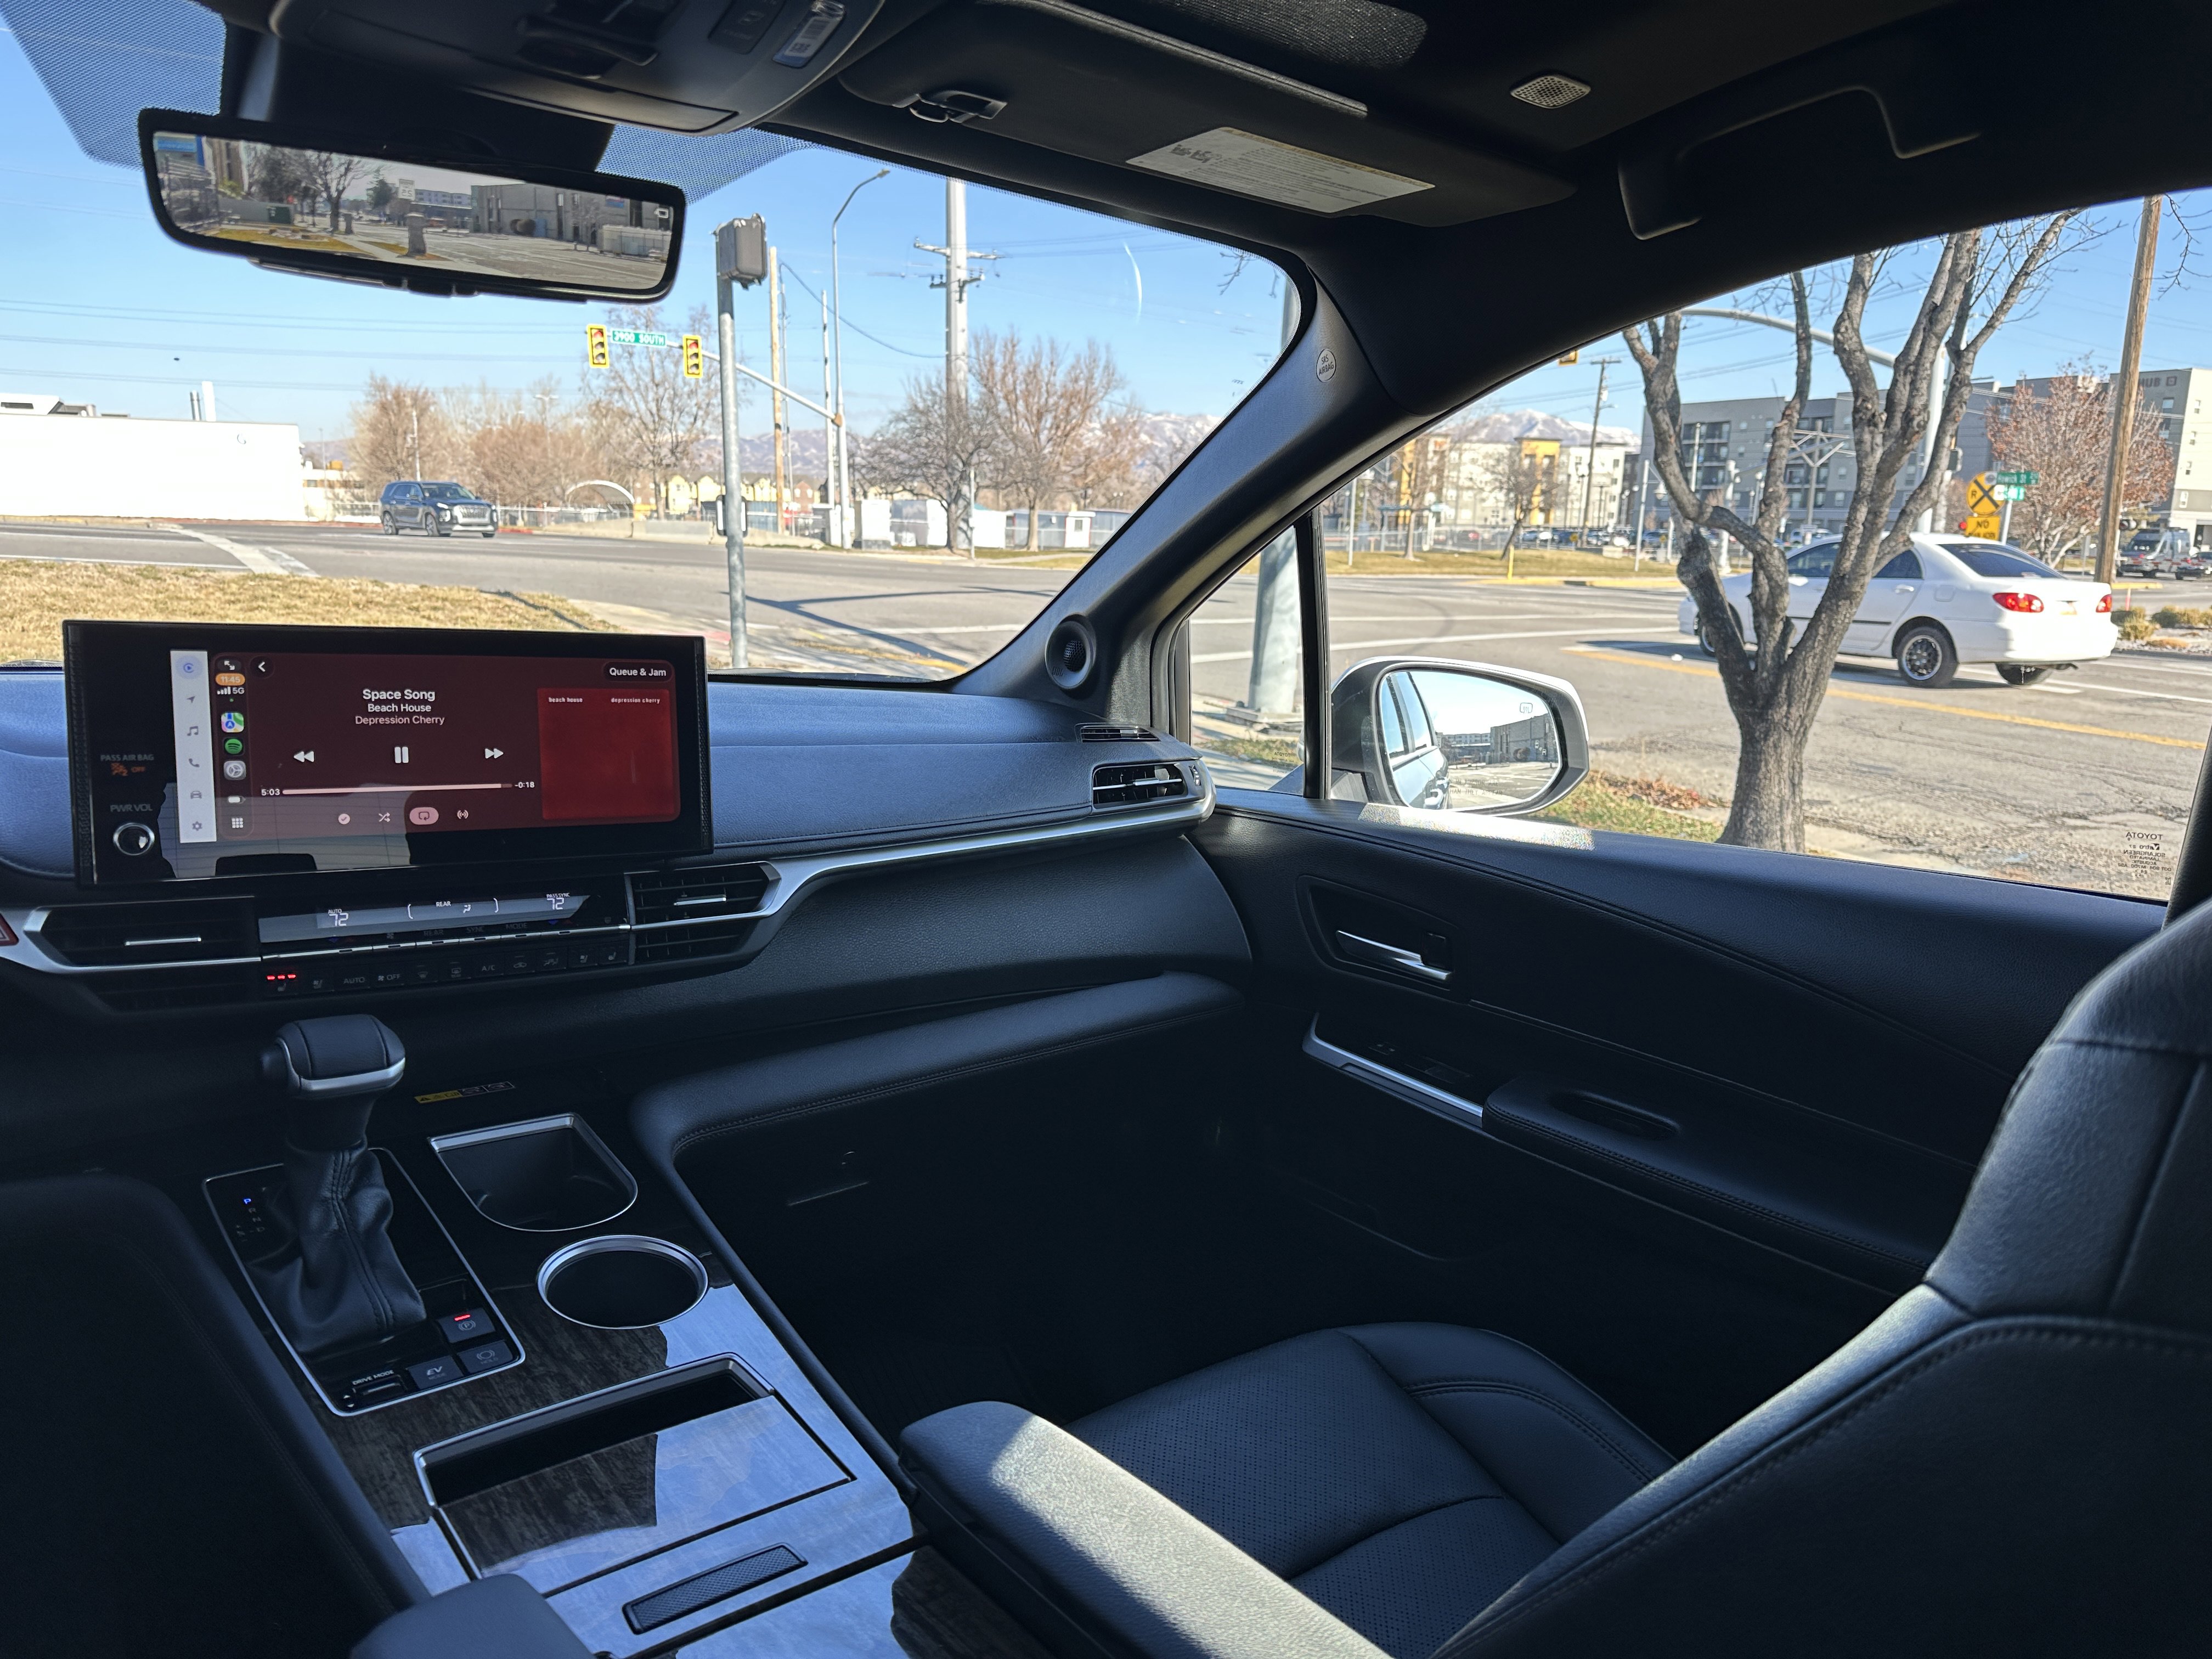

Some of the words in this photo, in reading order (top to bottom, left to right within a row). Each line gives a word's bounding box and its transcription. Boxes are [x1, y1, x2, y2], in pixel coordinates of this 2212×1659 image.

[614, 331, 635, 342] 3900
[639, 334, 664, 345] SOUTH
[1977, 519, 1989, 529] NO
[609, 667, 638, 676] Queue
[640, 668, 647, 676] &
[648, 668, 667, 676] Jam
[363, 689, 402, 701] Space
[404, 689, 436, 702] Song
[368, 703, 398, 712] Beach
[400, 703, 432, 712] House
[355, 715, 410, 725] Depression
[412, 715, 445, 725] Cherry
[546, 897, 565, 910] 72
[329, 912, 349, 926] 72
[426, 1365, 443, 1375] EV
[352, 1376, 373, 1385] DRIVE
[373, 1369, 394, 1379] MODE
